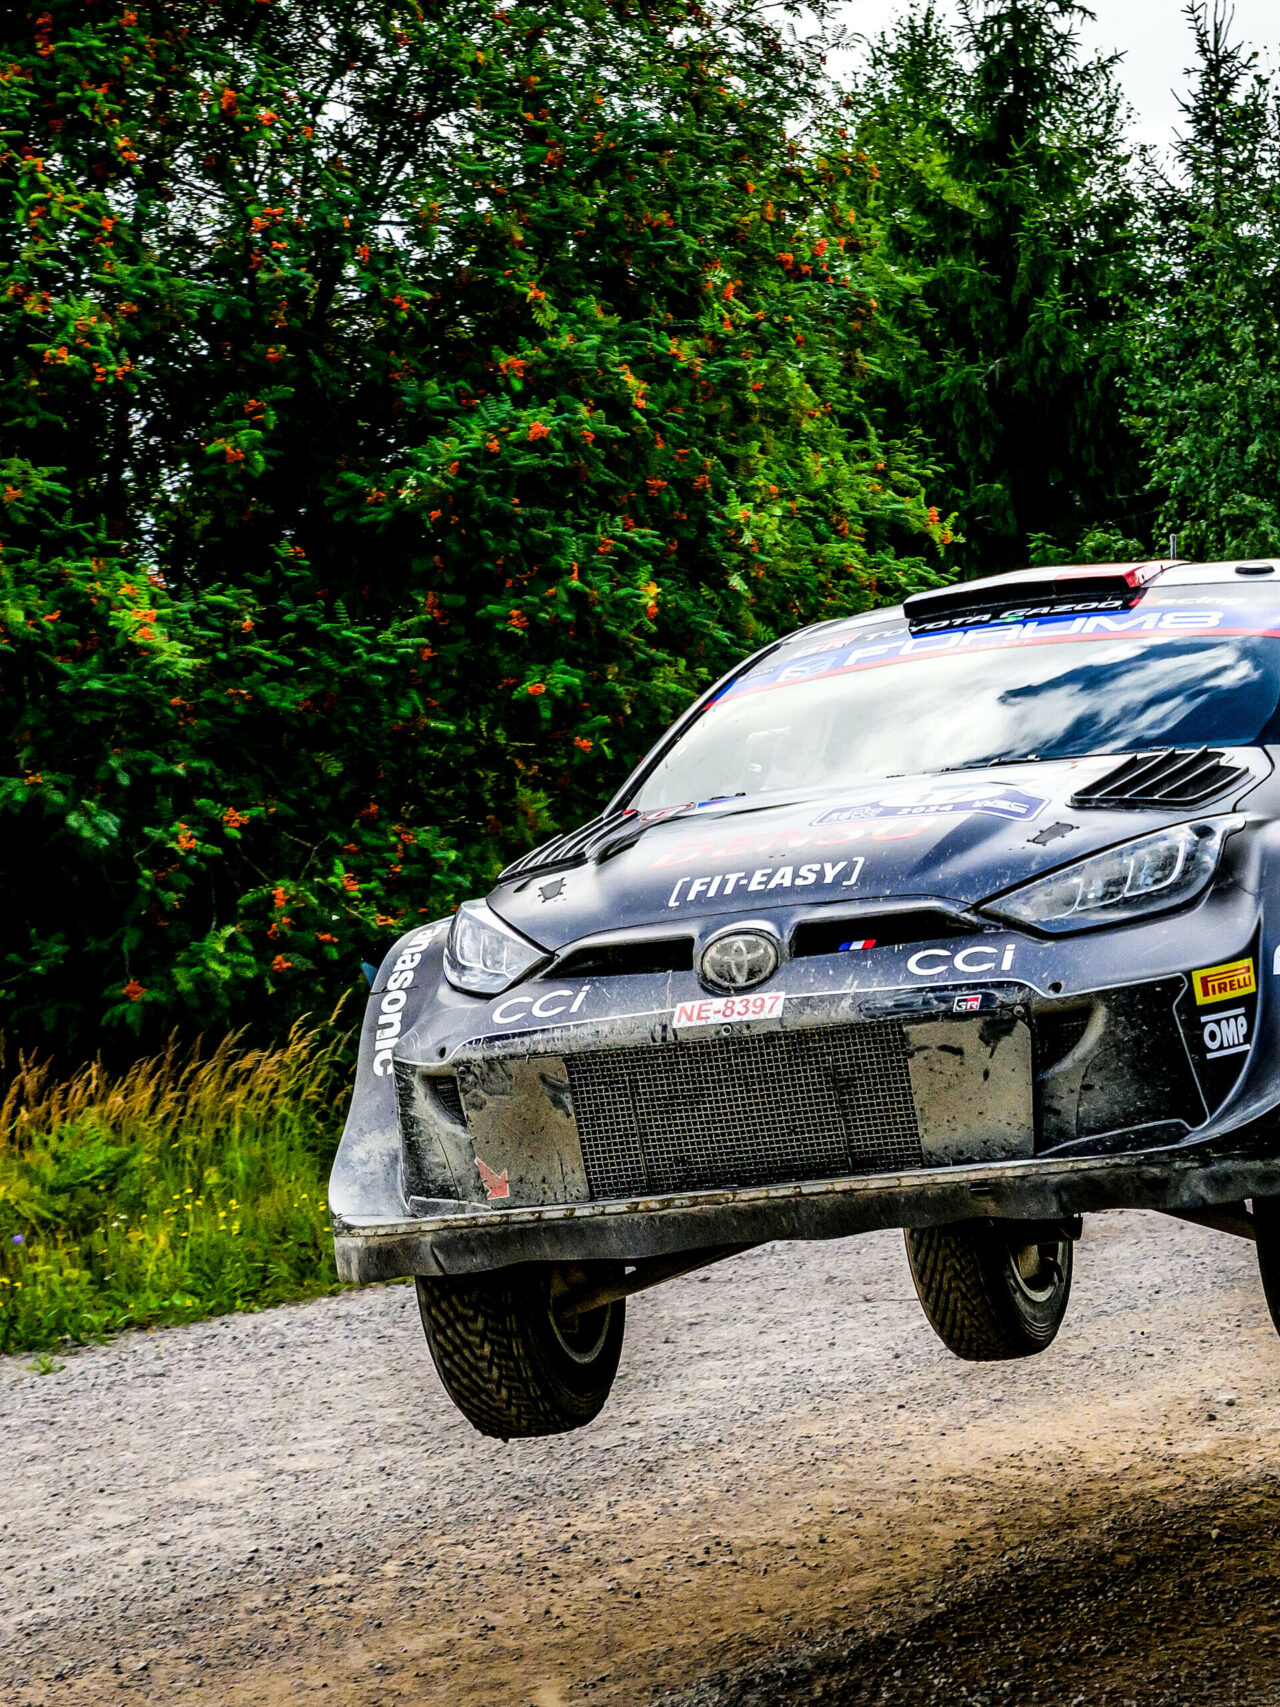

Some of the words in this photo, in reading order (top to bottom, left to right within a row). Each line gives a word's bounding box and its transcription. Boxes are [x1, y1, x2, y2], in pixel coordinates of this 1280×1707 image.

[998, 600, 1123, 618] GAZOO
[843, 611, 1224, 667] FORUM8
[897, 804, 954, 815] 2024
[651, 818, 939, 869] DENSO
[1200, 966, 1252, 997] PIRELLI
[373, 925, 442, 1077] anasonic
[677, 995, 781, 1023] NE-8397
[957, 1000, 979, 1010] GR
[1203, 1015, 1248, 1050] OMP
